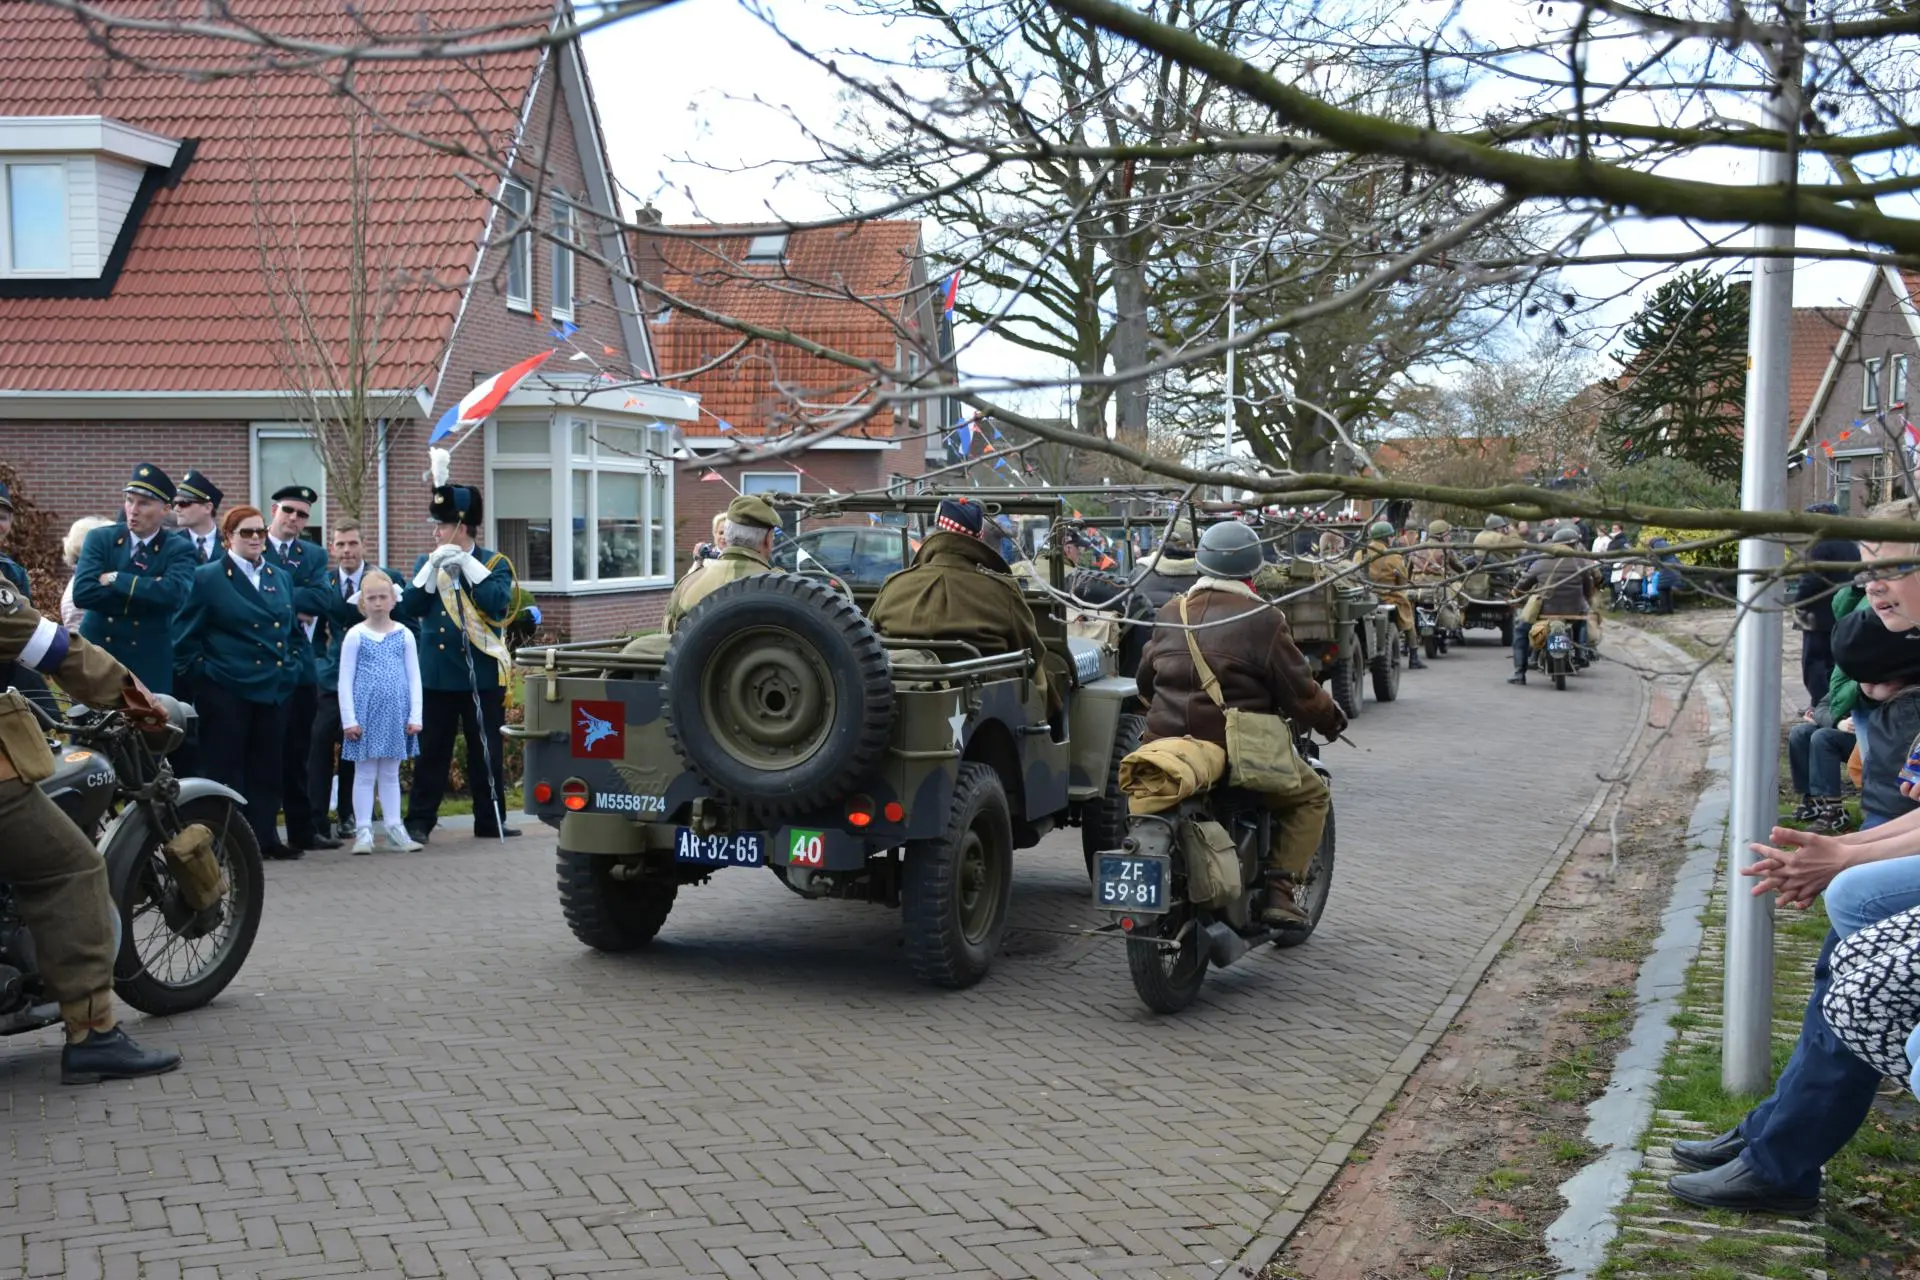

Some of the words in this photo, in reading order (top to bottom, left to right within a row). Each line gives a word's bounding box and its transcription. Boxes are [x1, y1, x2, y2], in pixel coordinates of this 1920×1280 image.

[595, 792, 666, 812] M5558724
[679, 831, 758, 863] AR-32-65
[792, 835, 822, 863] 40
[1120, 861, 1144, 881] ZF
